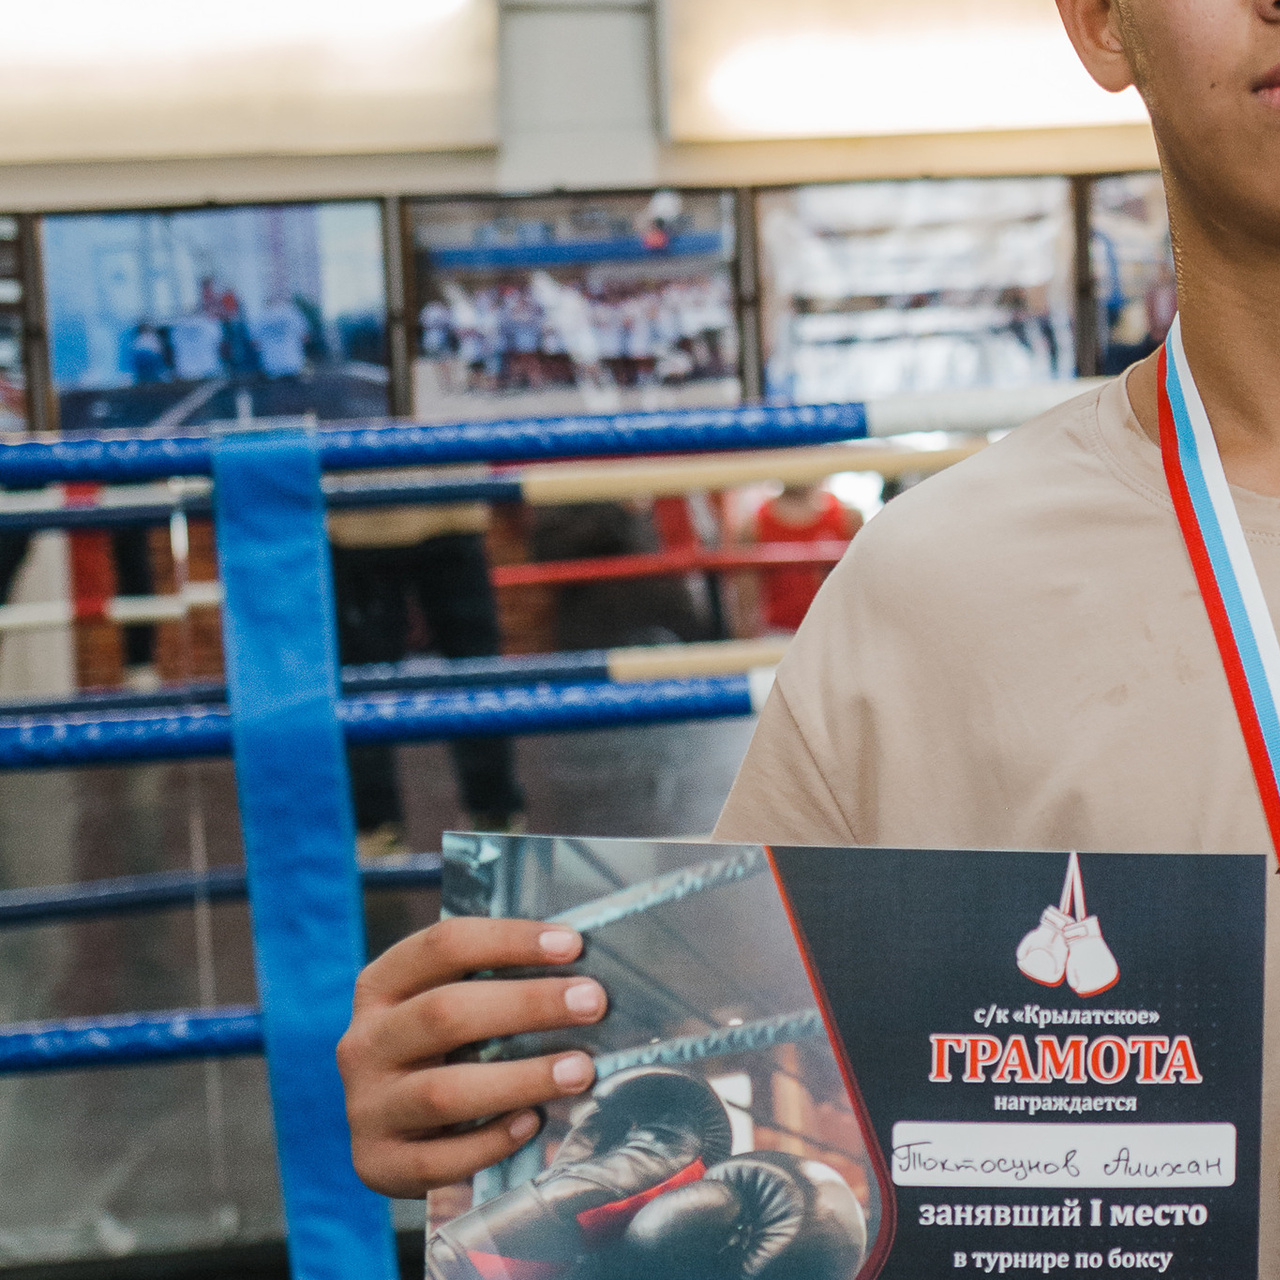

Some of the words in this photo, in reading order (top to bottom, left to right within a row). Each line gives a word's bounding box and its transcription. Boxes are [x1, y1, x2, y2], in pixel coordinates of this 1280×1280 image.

[973, 1003, 1008, 1029] с/к
[1012, 1003, 1160, 1029] «Крылатское»
[929, 1033, 1203, 1084] ГРАМОТА
[994, 1093, 1138, 1115] награждается
[894, 1141, 1080, 1180] Токтосунов
[1103, 1147, 1223, 1177] Алихан
[918, 1198, 1081, 1227] занявший
[1109, 1202, 1209, 1227] место
[953, 1251, 968, 1268] в
[972, 1251, 1070, 1274] турнире
[1075, 1252, 1104, 1269] по
[1107, 1248, 1174, 1273] боксу
